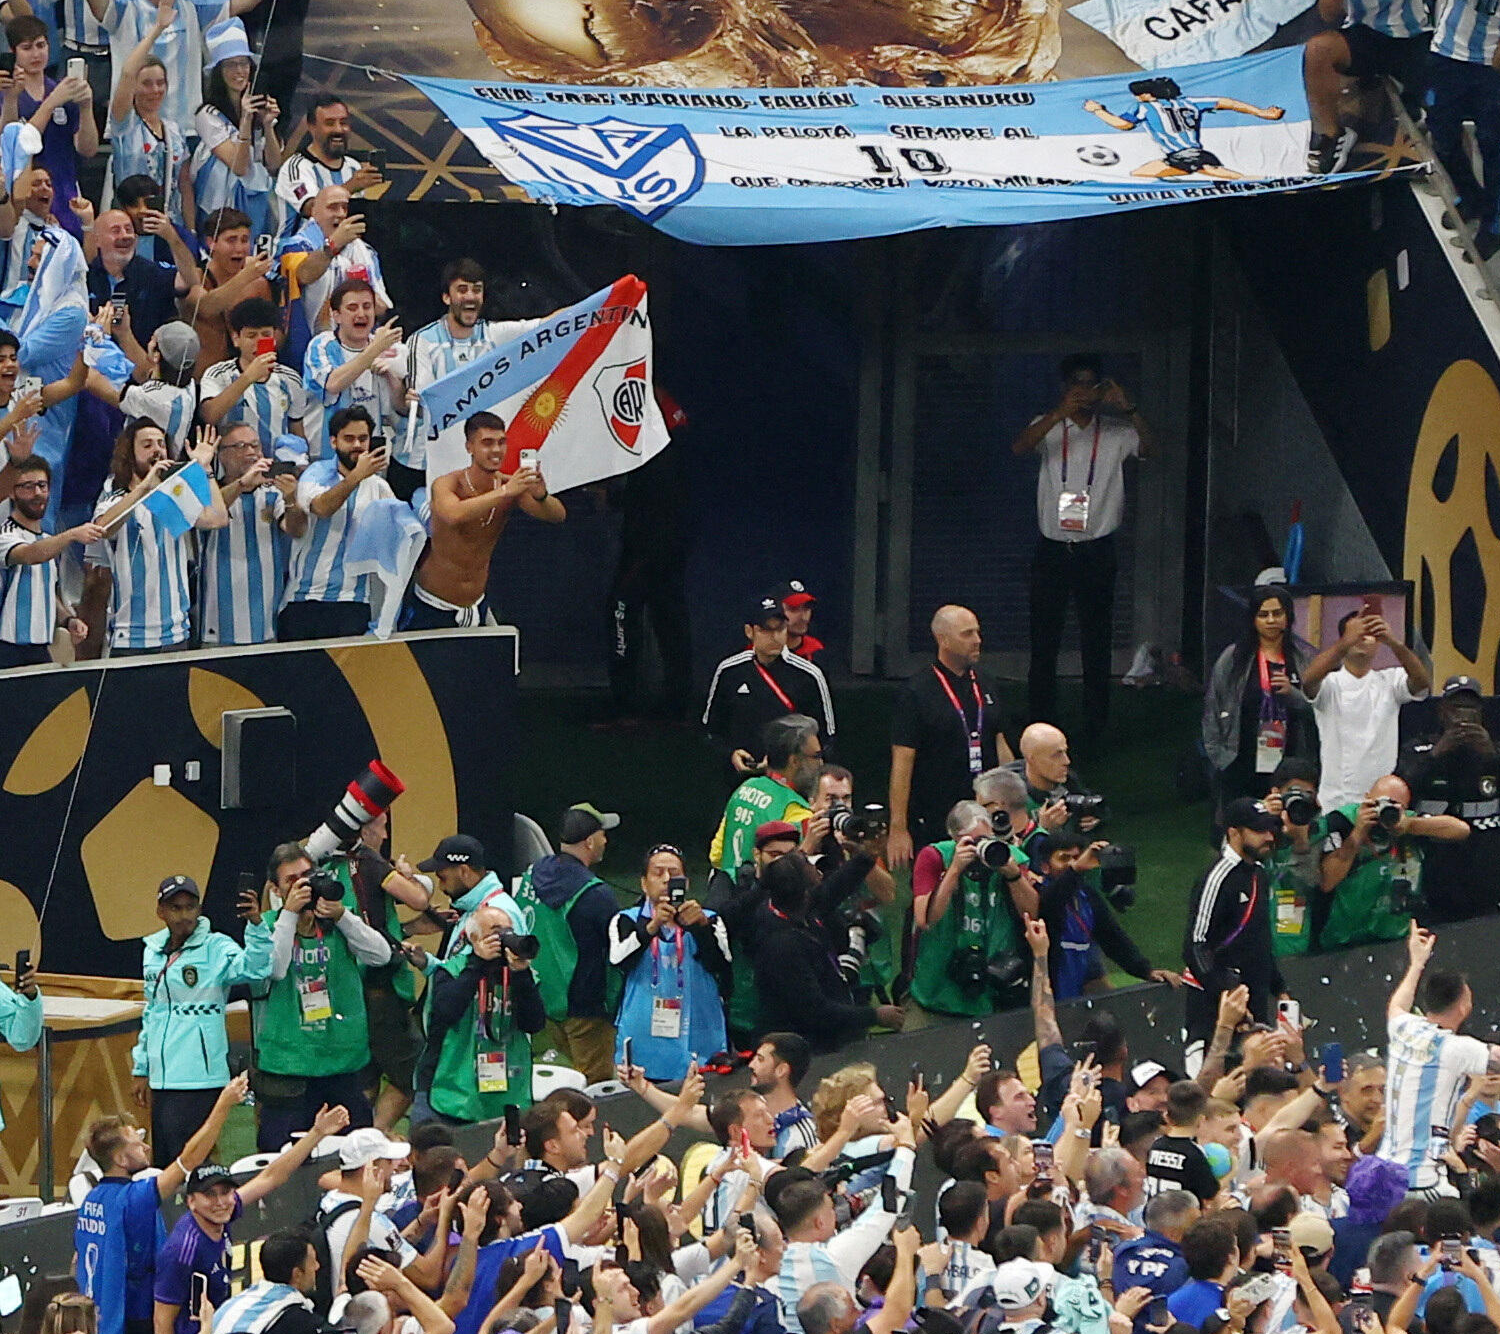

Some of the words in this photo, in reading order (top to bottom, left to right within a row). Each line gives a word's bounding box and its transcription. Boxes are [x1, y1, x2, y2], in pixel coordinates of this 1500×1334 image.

[859, 144, 951, 176] 10
[1150, 1151, 1185, 1169] MESSI
[16, 1205, 28, 1219] 31
[84, 1202, 105, 1219] FIFA
[1127, 1260, 1167, 1277] YPF
